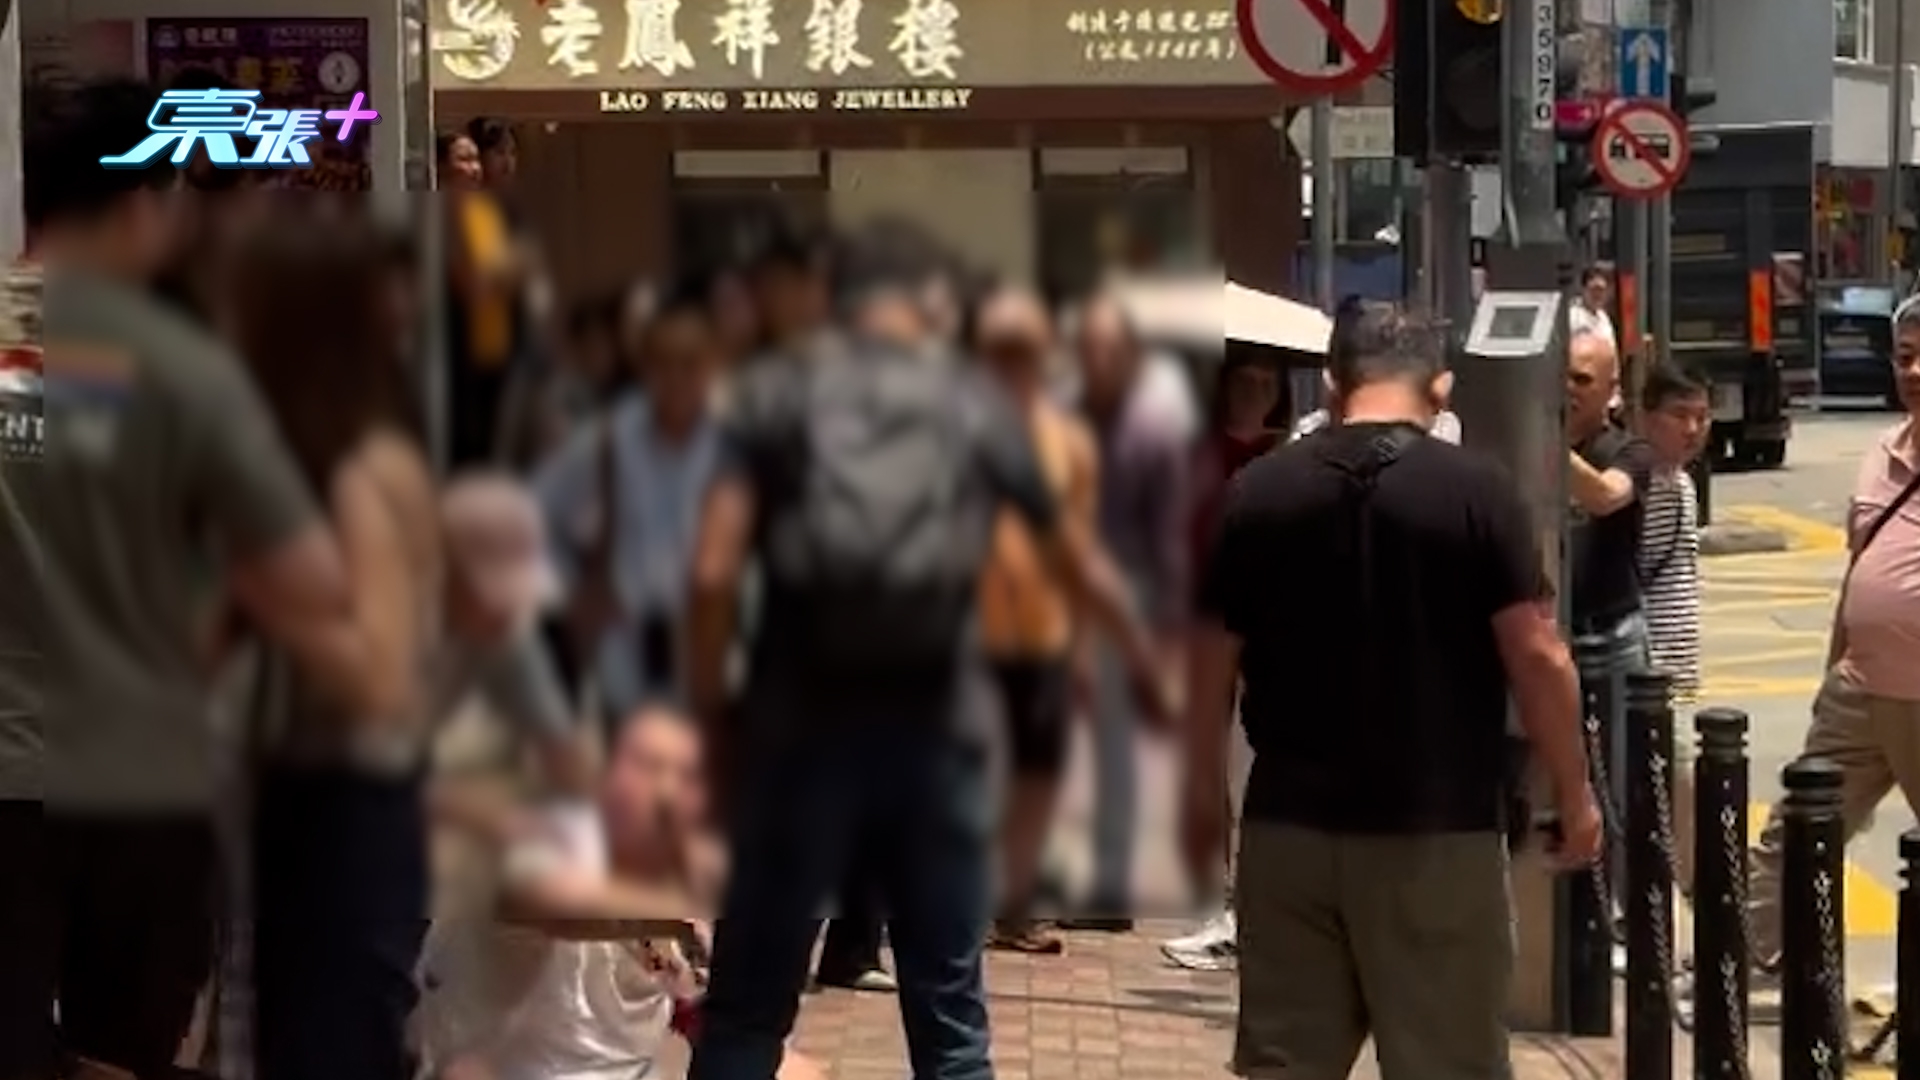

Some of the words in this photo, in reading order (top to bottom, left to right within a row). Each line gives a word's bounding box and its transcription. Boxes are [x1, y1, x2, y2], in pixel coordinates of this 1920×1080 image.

[541, 0, 963, 79] 老鳳祥銀樓
[600, 91, 648, 111] LAO
[662, 91, 728, 110] FENG
[743, 91, 819, 110] XIANG
[831, 88, 973, 110] JEWELLERY
